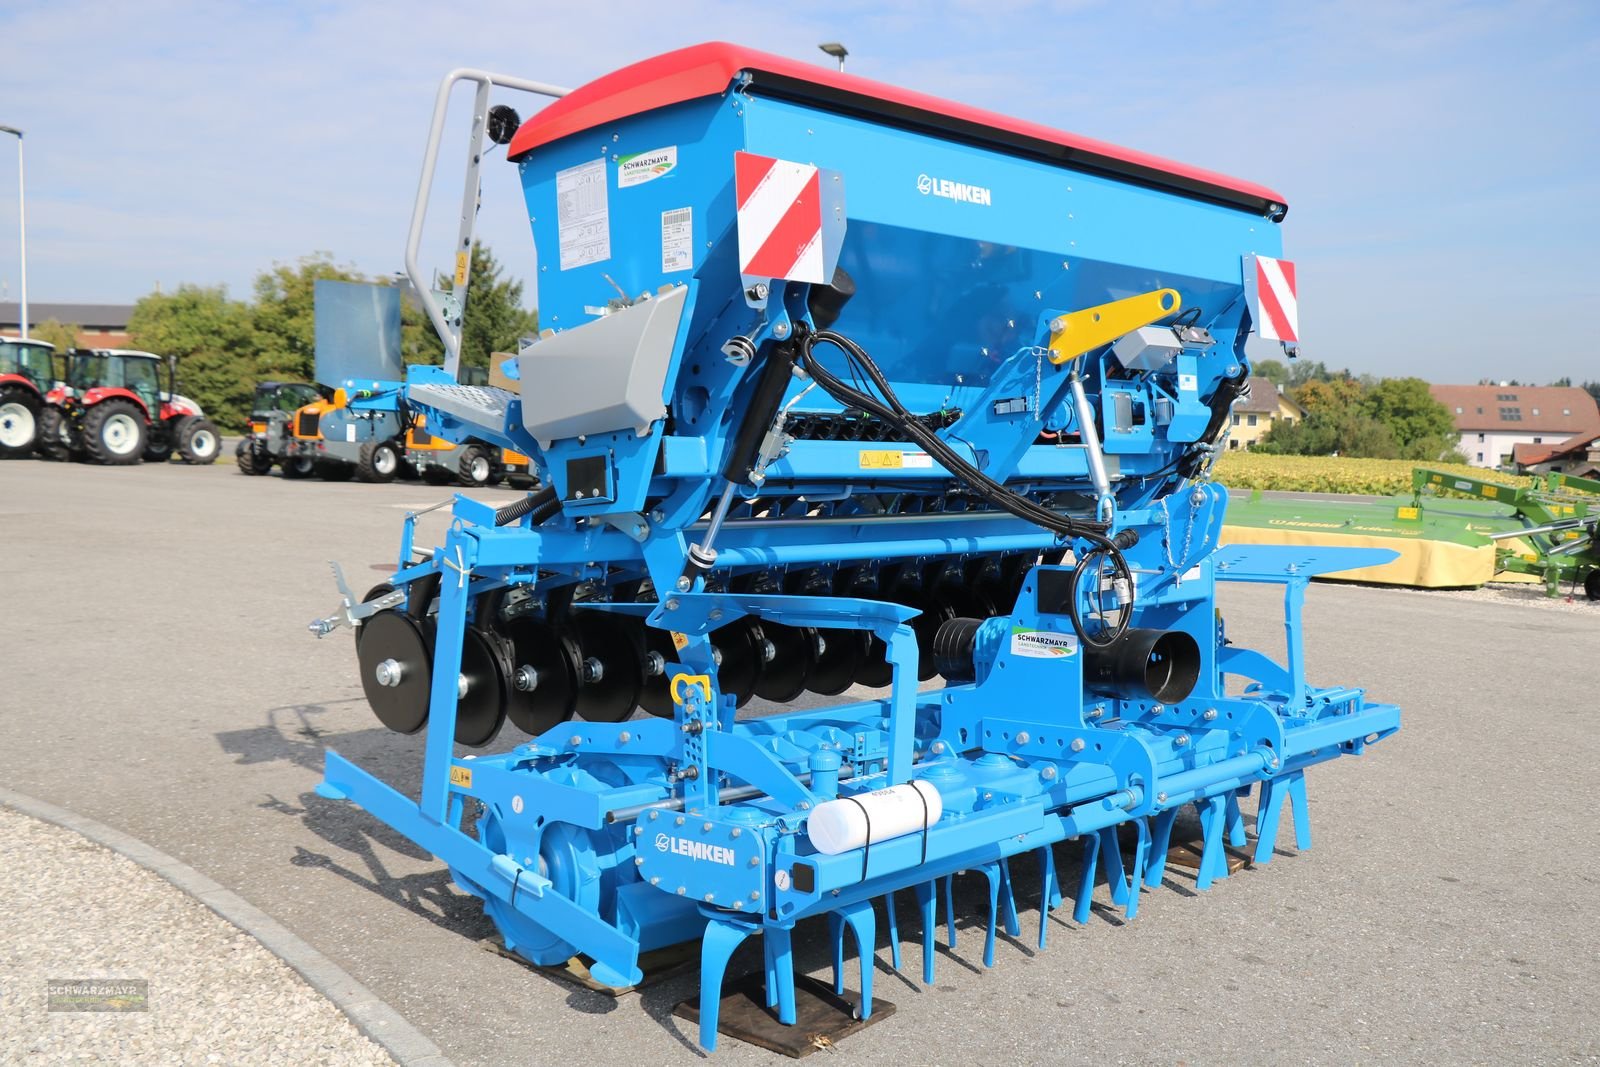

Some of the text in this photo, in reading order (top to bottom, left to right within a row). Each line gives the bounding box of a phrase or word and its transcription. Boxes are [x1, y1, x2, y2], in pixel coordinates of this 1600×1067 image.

[623, 155, 668, 170] SCHWARZMAYR
[932, 177, 991, 206] LEMKEN
[1017, 634, 1068, 647] SCHWARZMAYR
[670, 836, 735, 866] LEMKEN
